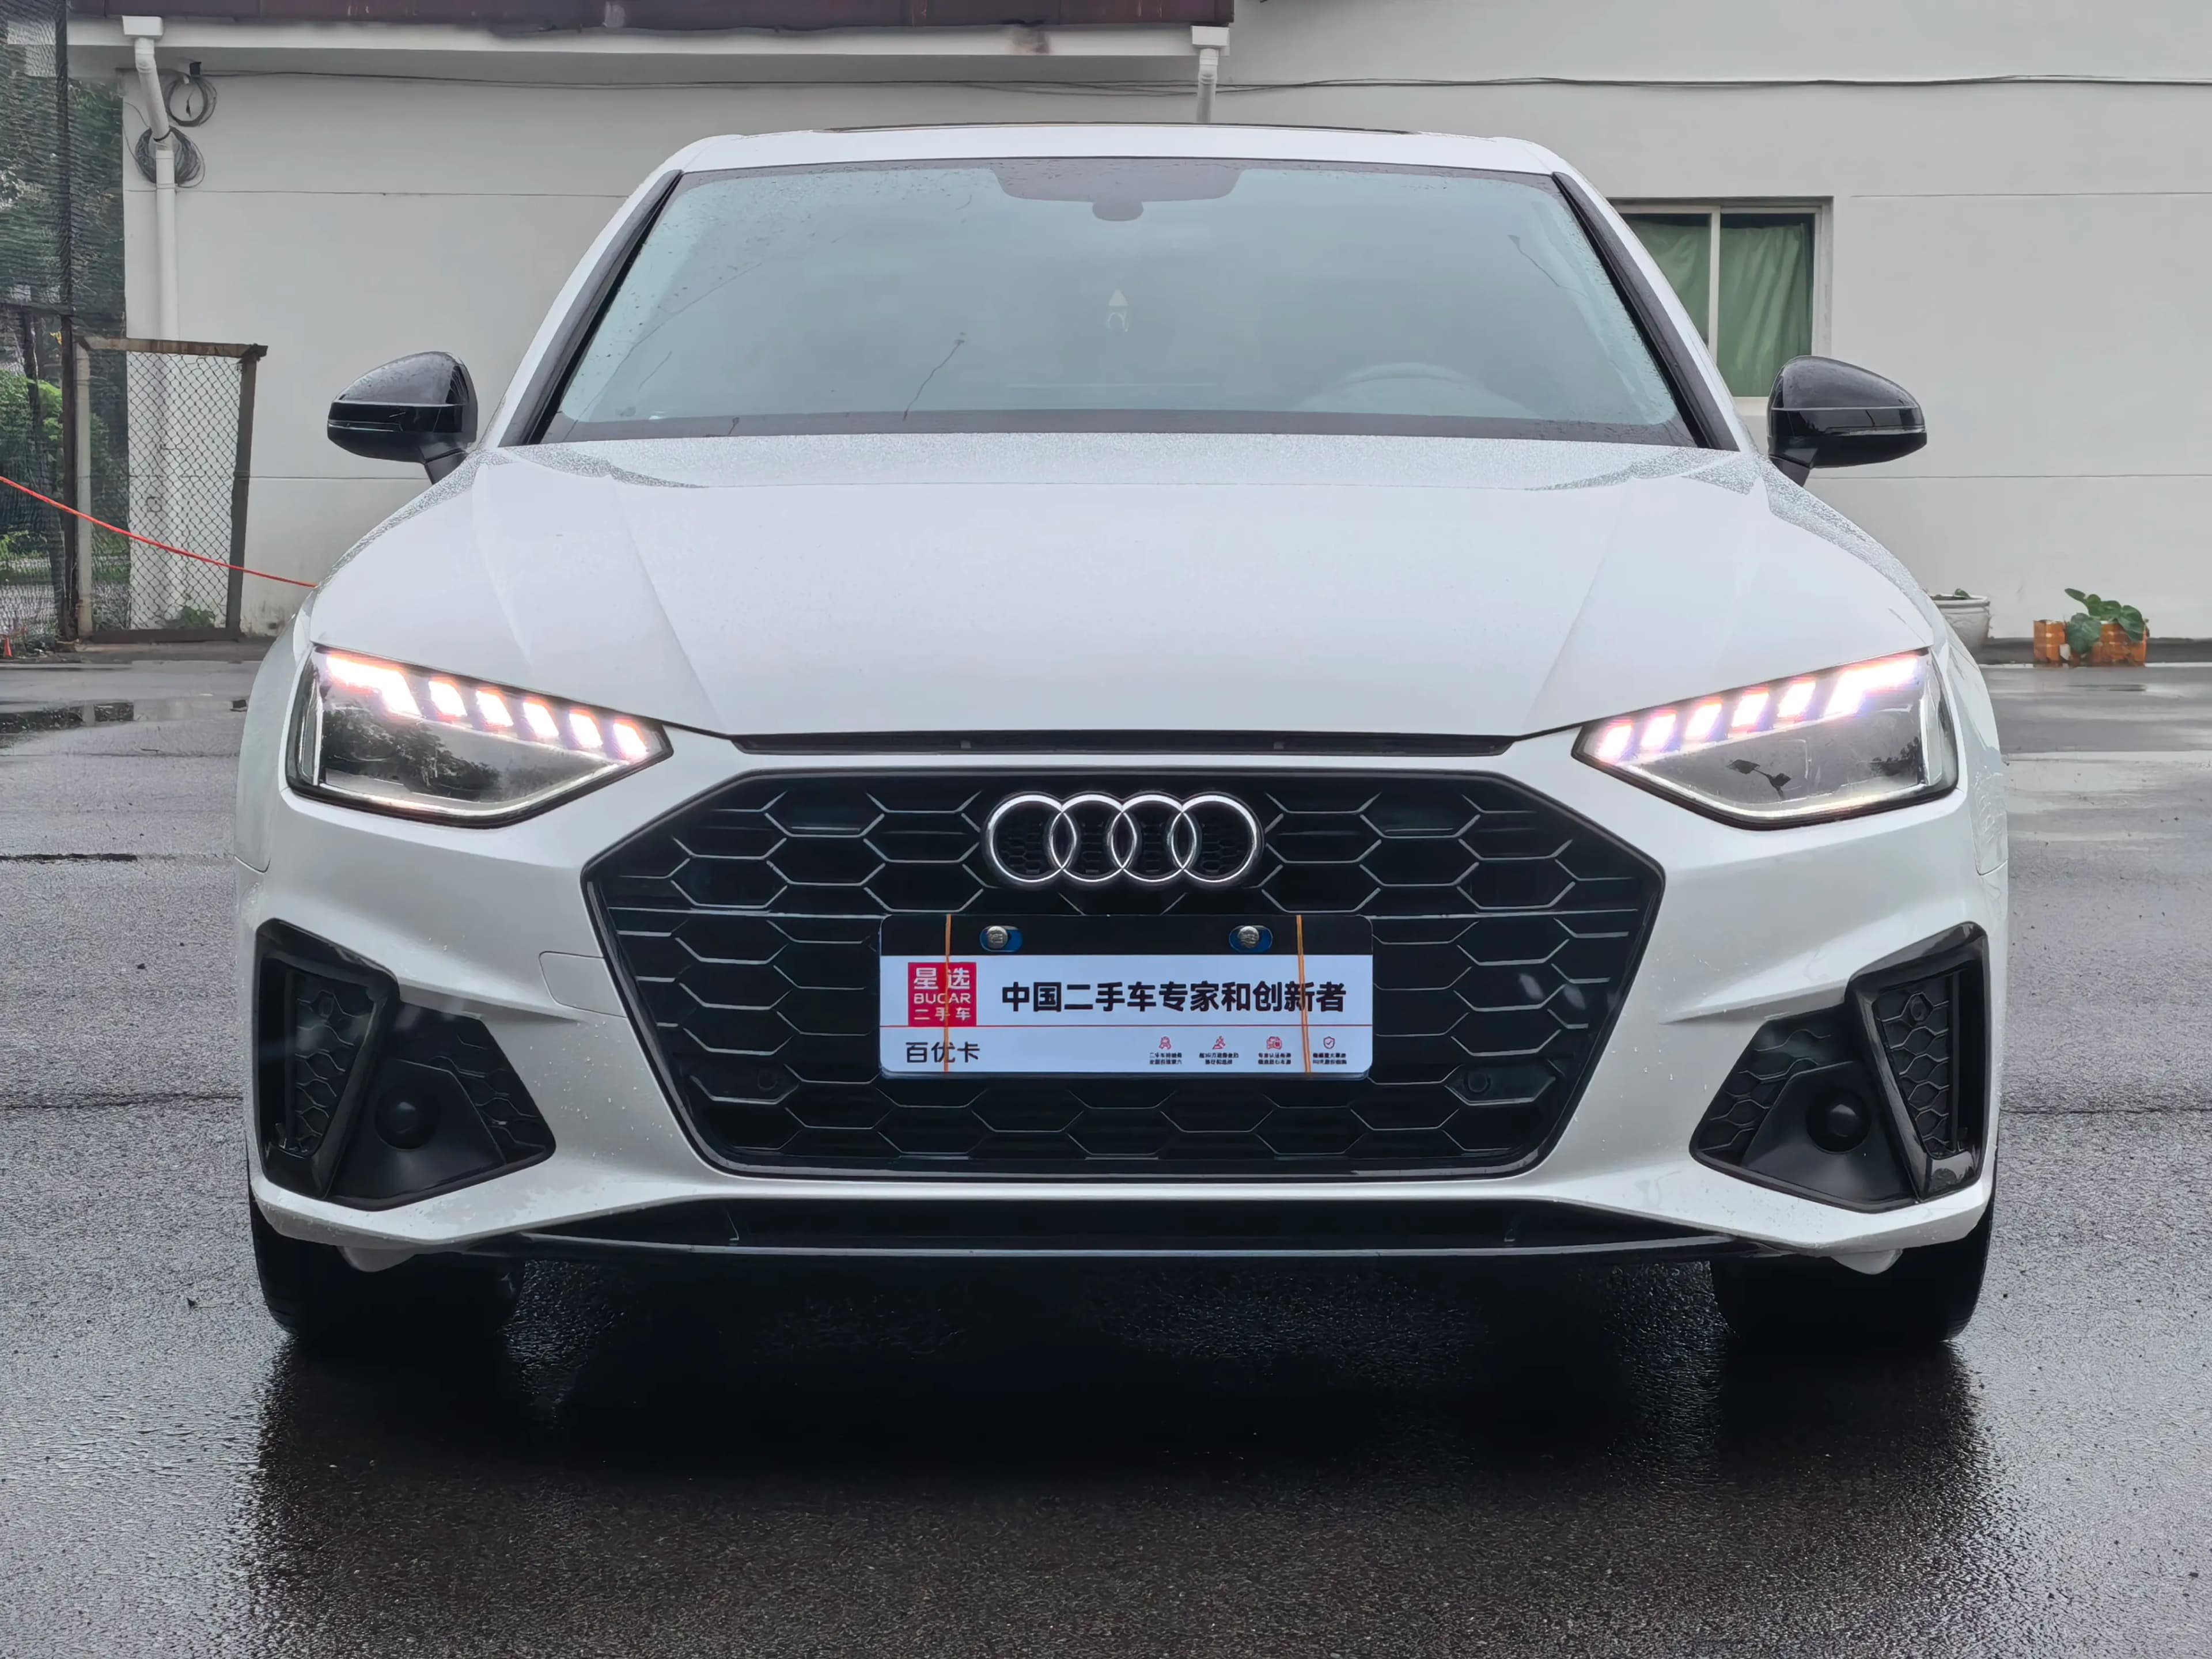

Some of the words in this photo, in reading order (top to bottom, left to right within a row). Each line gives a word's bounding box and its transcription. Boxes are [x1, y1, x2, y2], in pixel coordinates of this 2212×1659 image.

[914, 967, 970, 990] 星选
[914, 993, 971, 1004] BUCAR
[1001, 981, 1347, 1013] 中国二手车专家和创新者
[914, 1006, 971, 1021] 二手车
[906, 1041, 980, 1063] 百优卡
